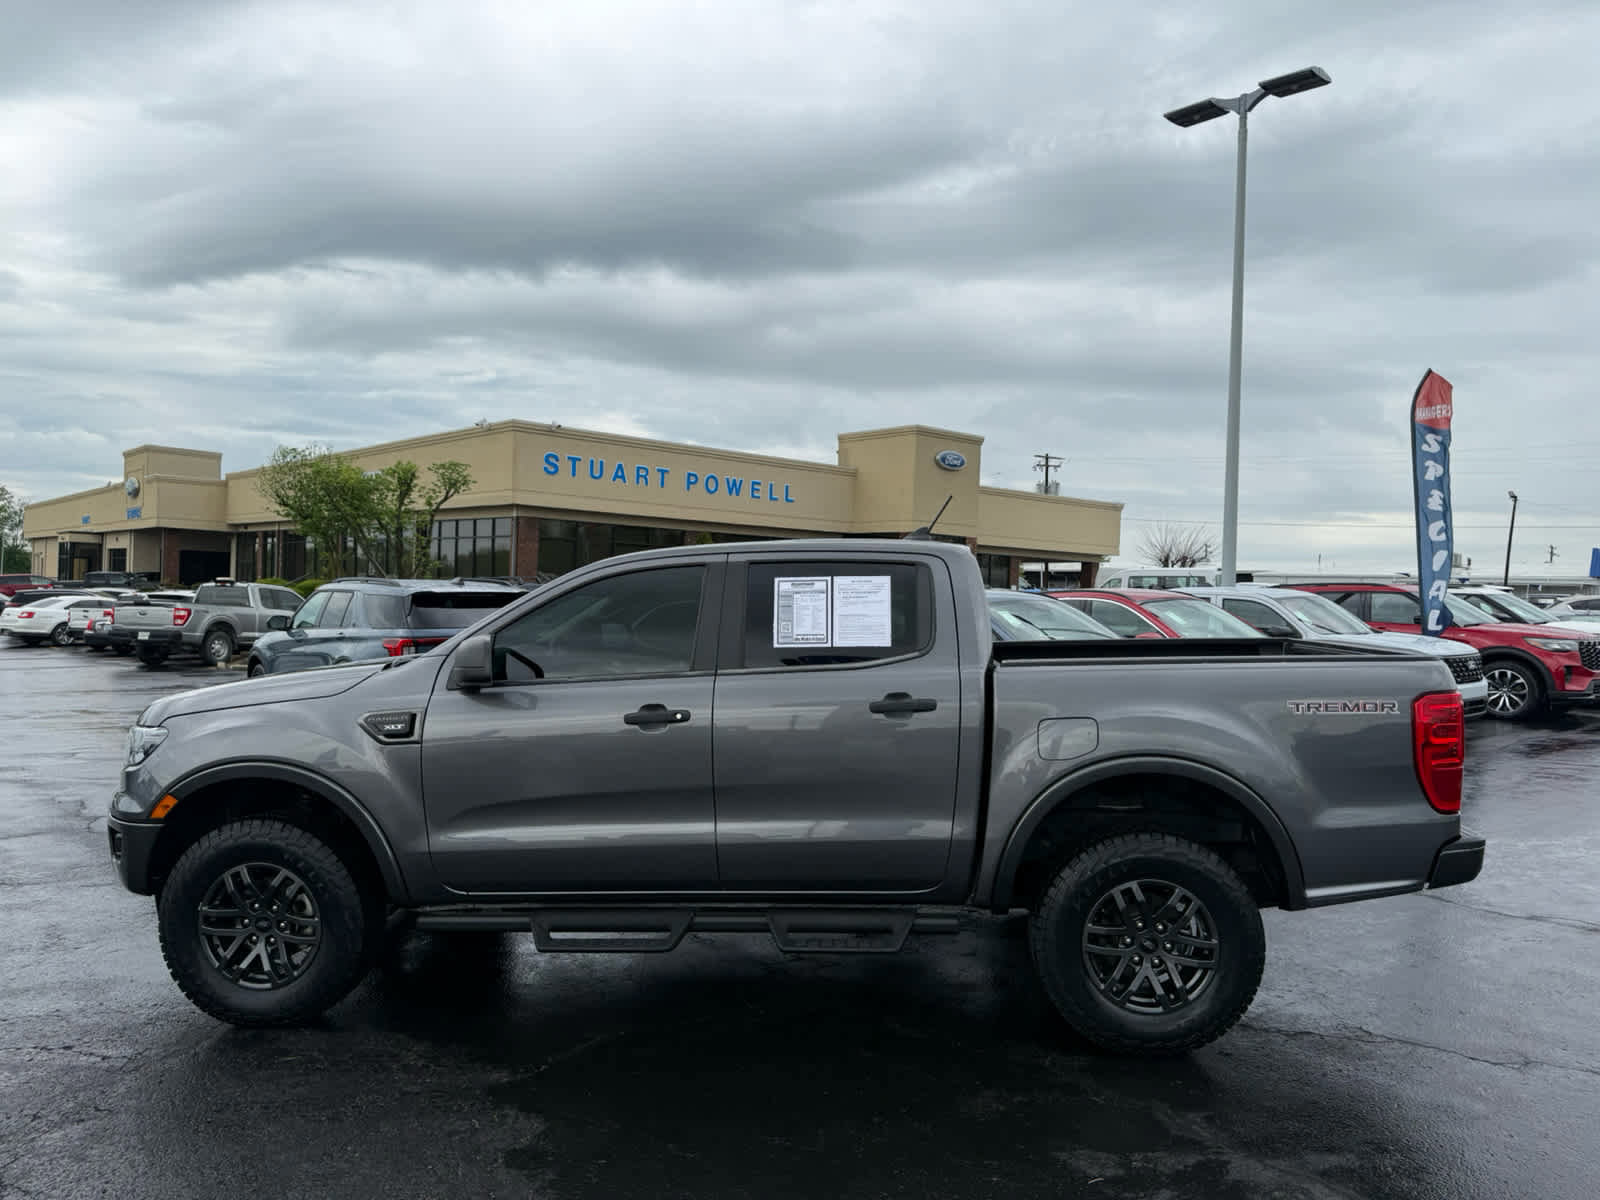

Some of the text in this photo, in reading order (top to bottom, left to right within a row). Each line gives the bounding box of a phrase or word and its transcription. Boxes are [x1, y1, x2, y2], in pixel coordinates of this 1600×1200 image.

[942, 454, 962, 466] Ford
[543, 452, 795, 503] STUART POWELL
[1421, 433, 1448, 630] SPECIAL
[1286, 700, 1400, 714] TREMOR
